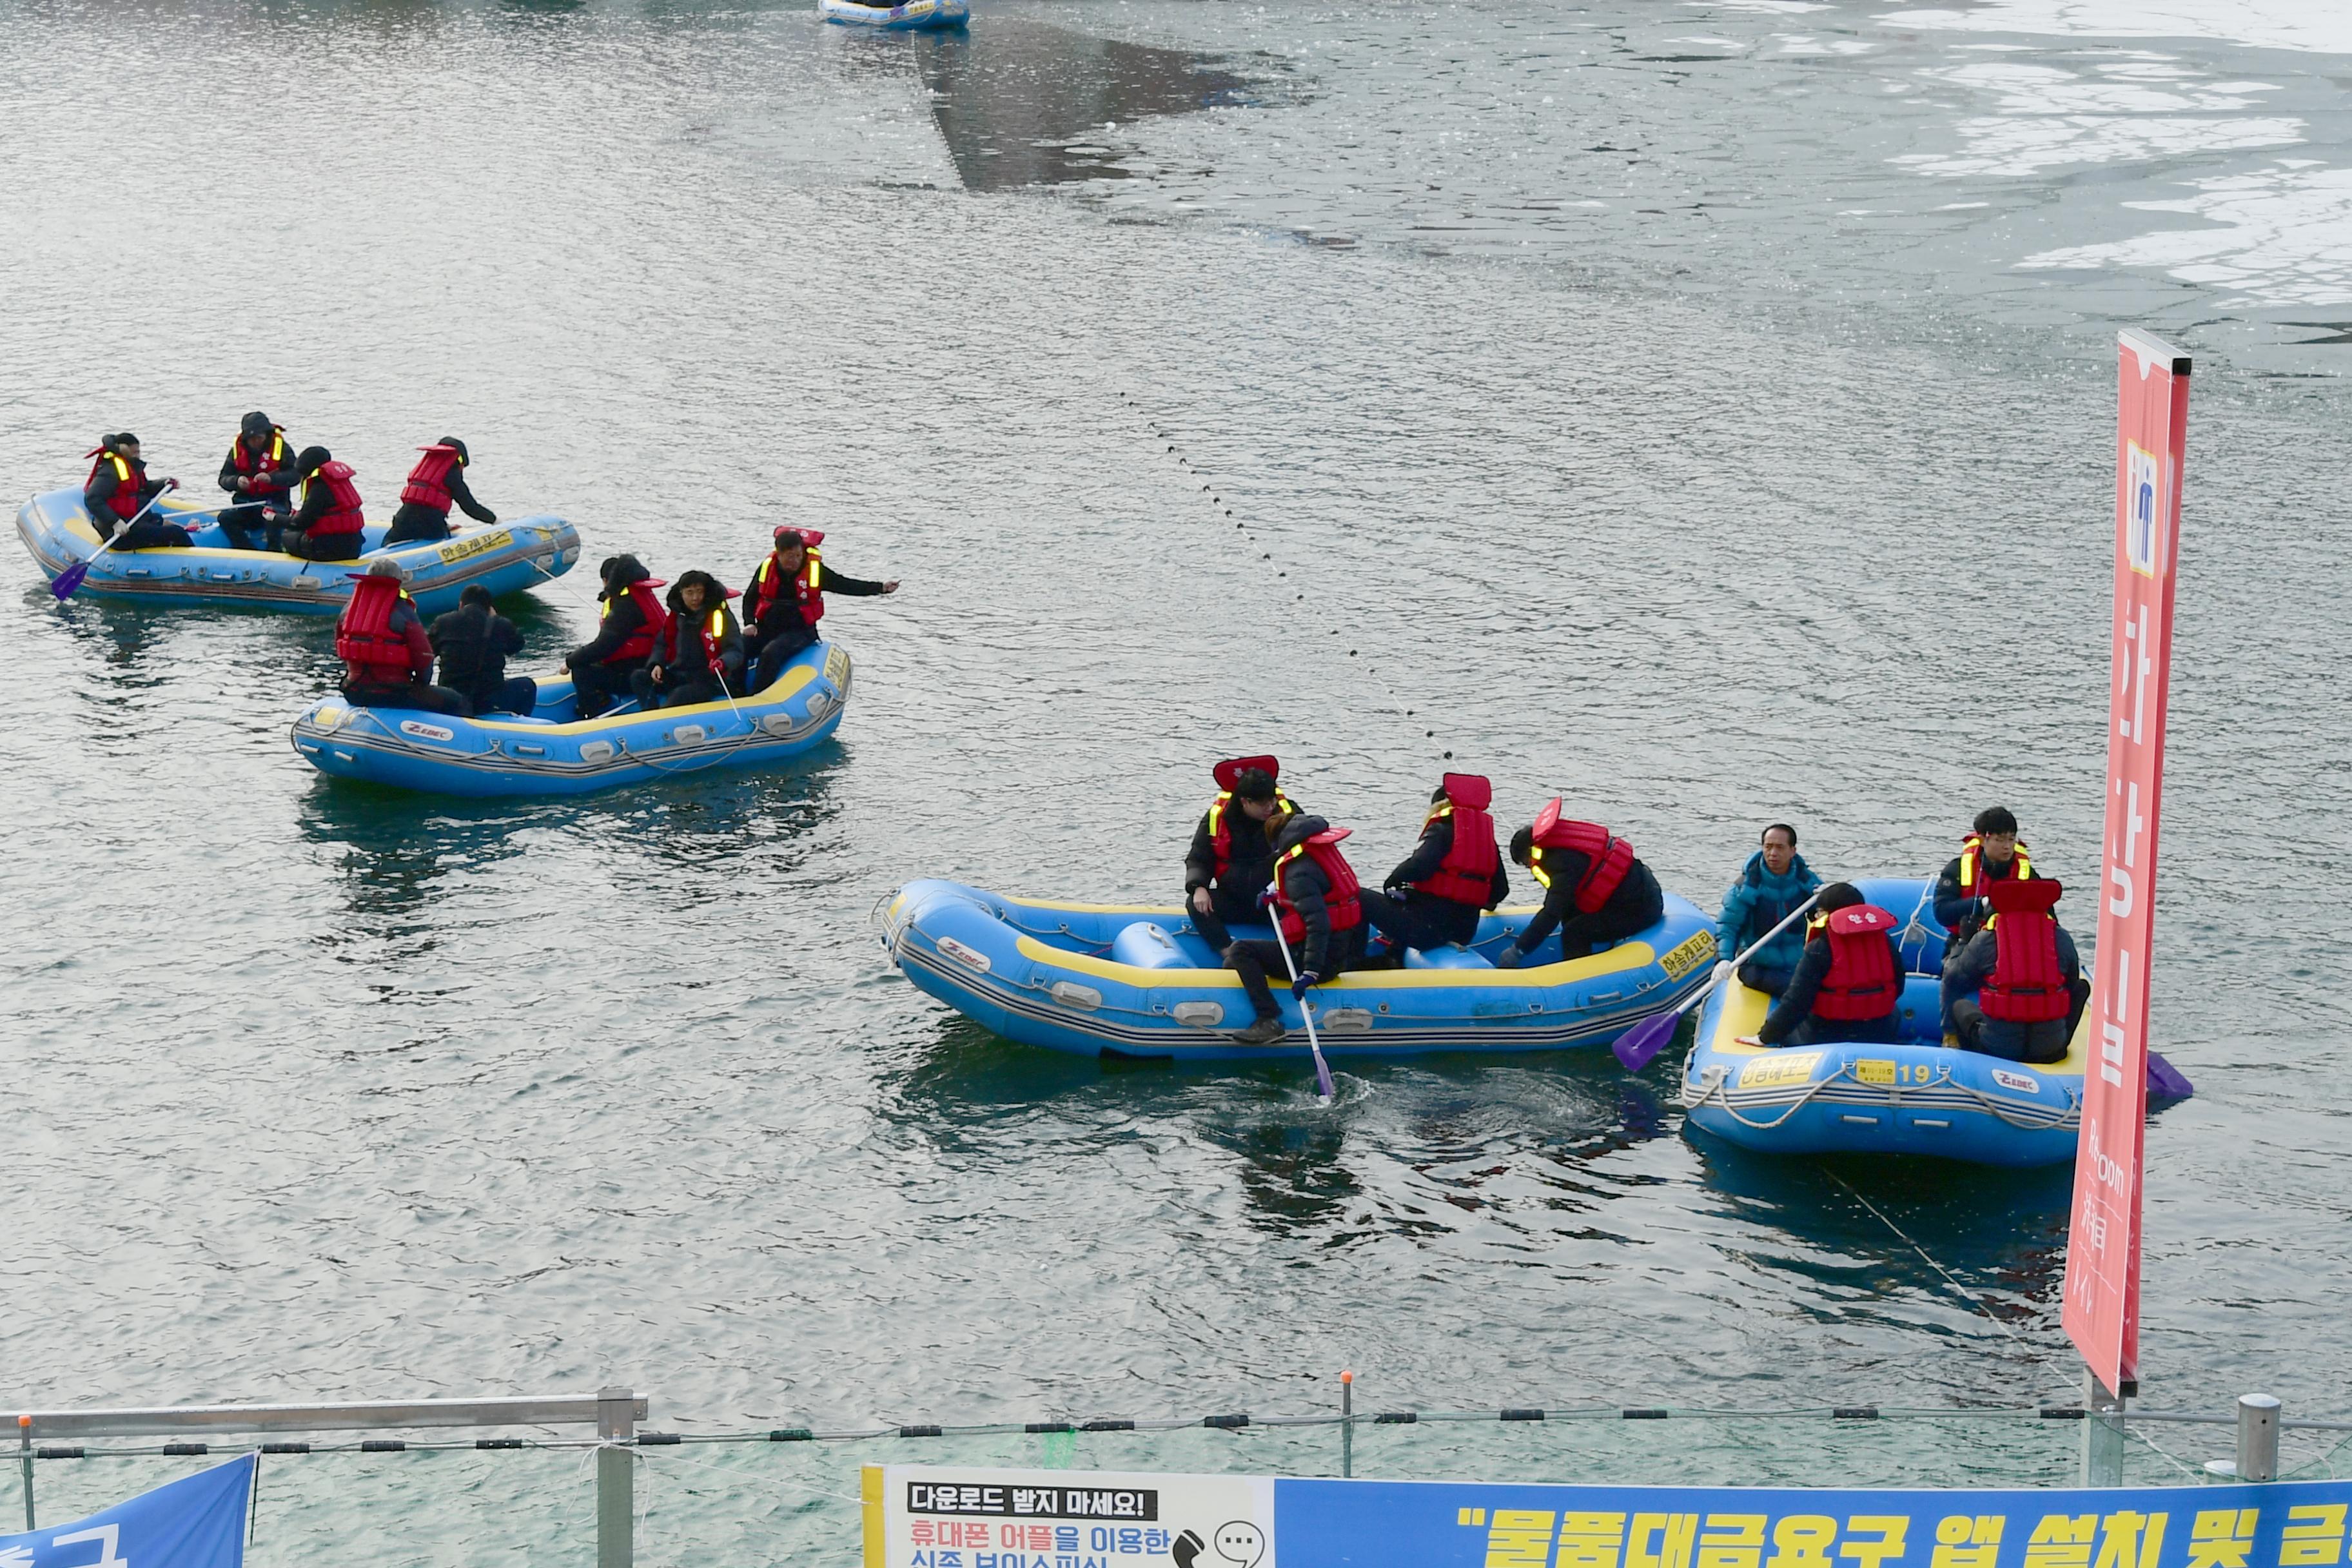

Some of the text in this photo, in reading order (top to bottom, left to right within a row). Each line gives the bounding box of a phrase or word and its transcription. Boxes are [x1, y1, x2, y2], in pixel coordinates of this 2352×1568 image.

[1899, 1064, 1930, 1083] 19
[911, 1485, 1144, 1516] 다운로드 받지 마세요!
[910, 1520, 1171, 1554] 휴대폰 어플을 이용한
[1930, 1515, 2006, 1568] 앱
[2023, 1510, 2169, 1568] 설치
[2186, 1508, 2259, 1568] 및
